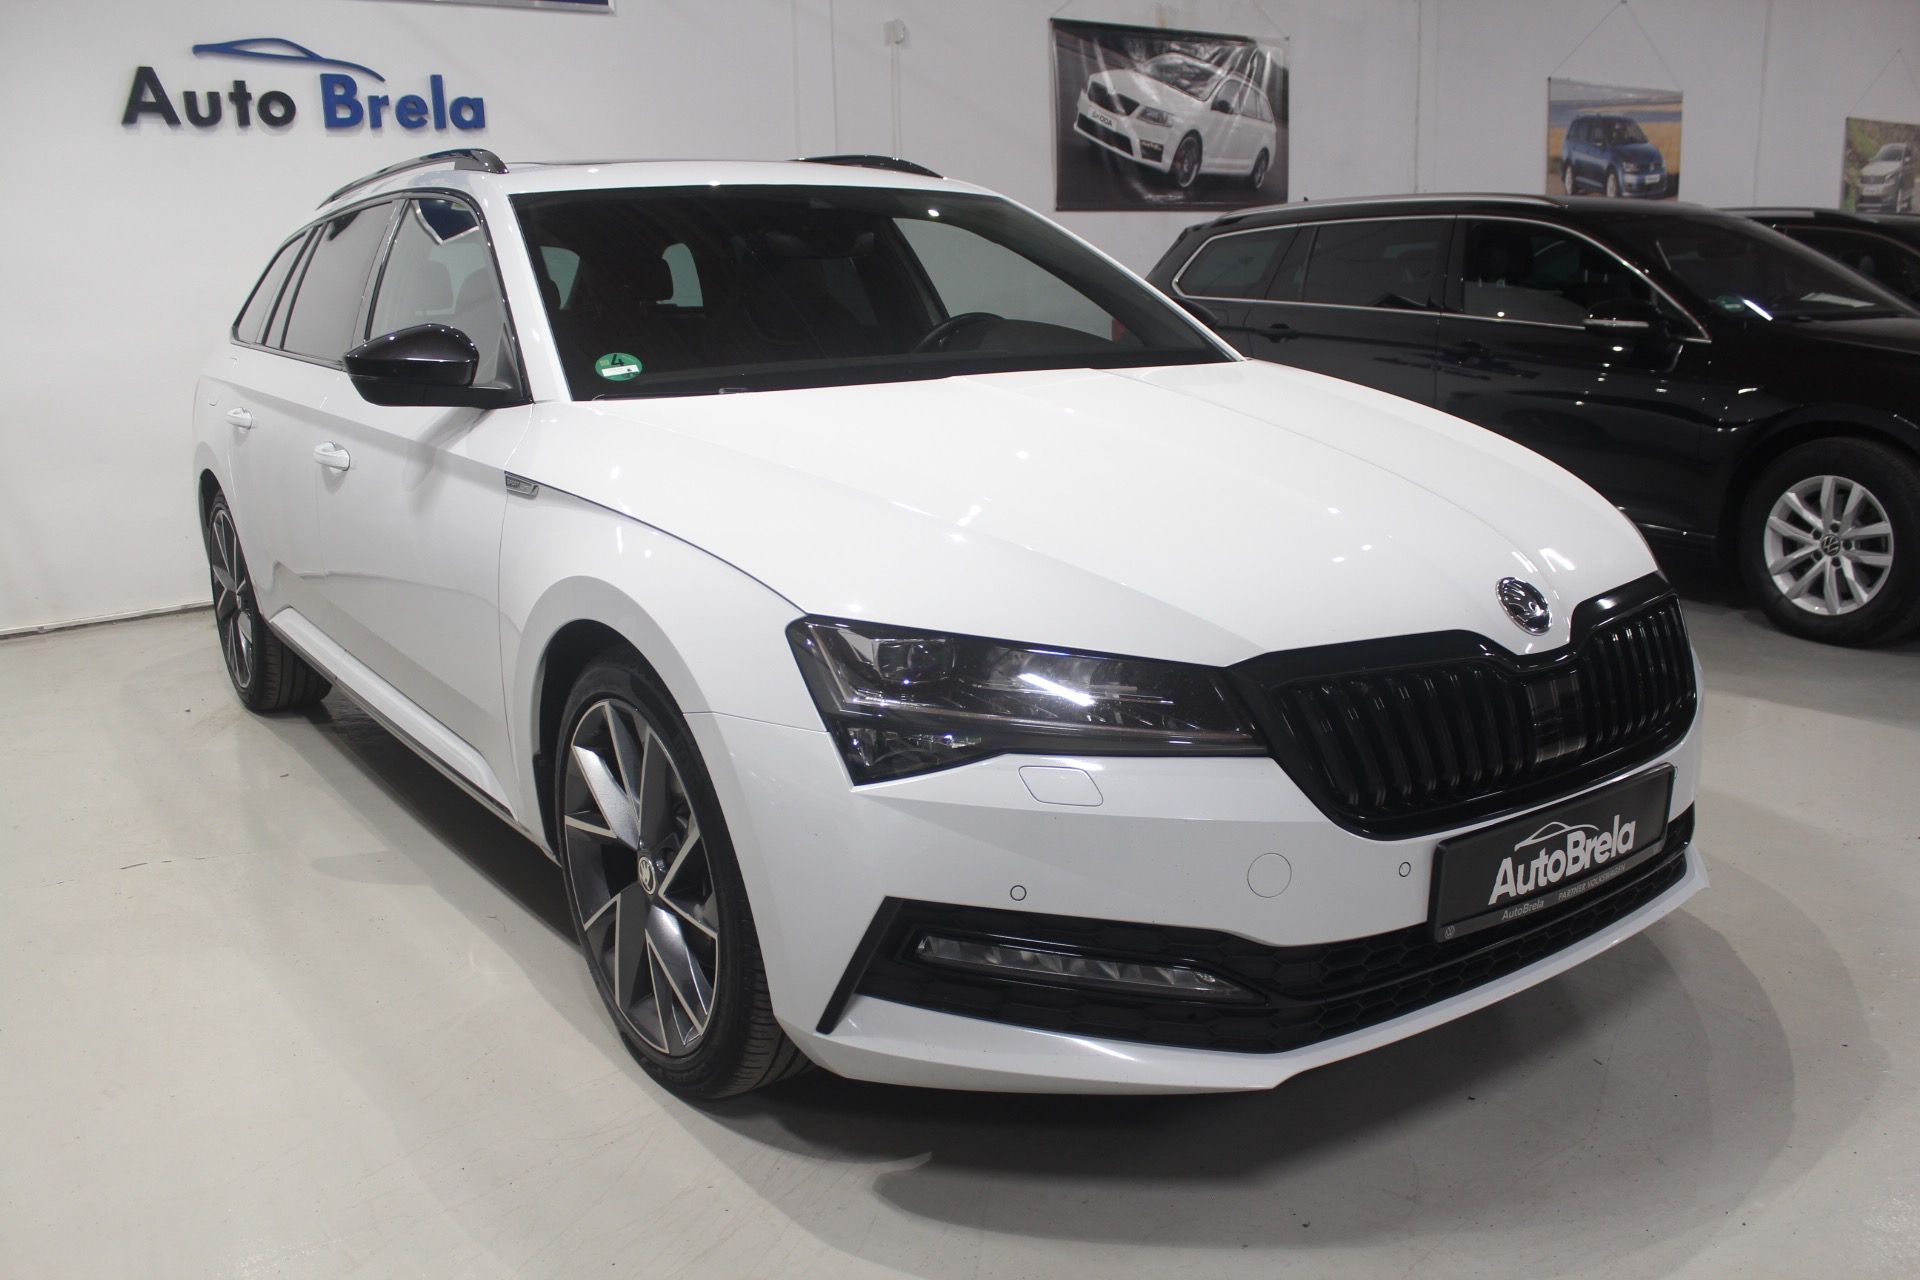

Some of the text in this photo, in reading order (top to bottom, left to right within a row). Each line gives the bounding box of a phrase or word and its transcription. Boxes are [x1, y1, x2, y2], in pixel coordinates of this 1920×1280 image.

[121, 65, 487, 130] Auto Brela
[611, 353, 625, 366] 4
[1488, 814, 1636, 906] AutoBrela
[1502, 899, 1545, 921] AutoBrela
